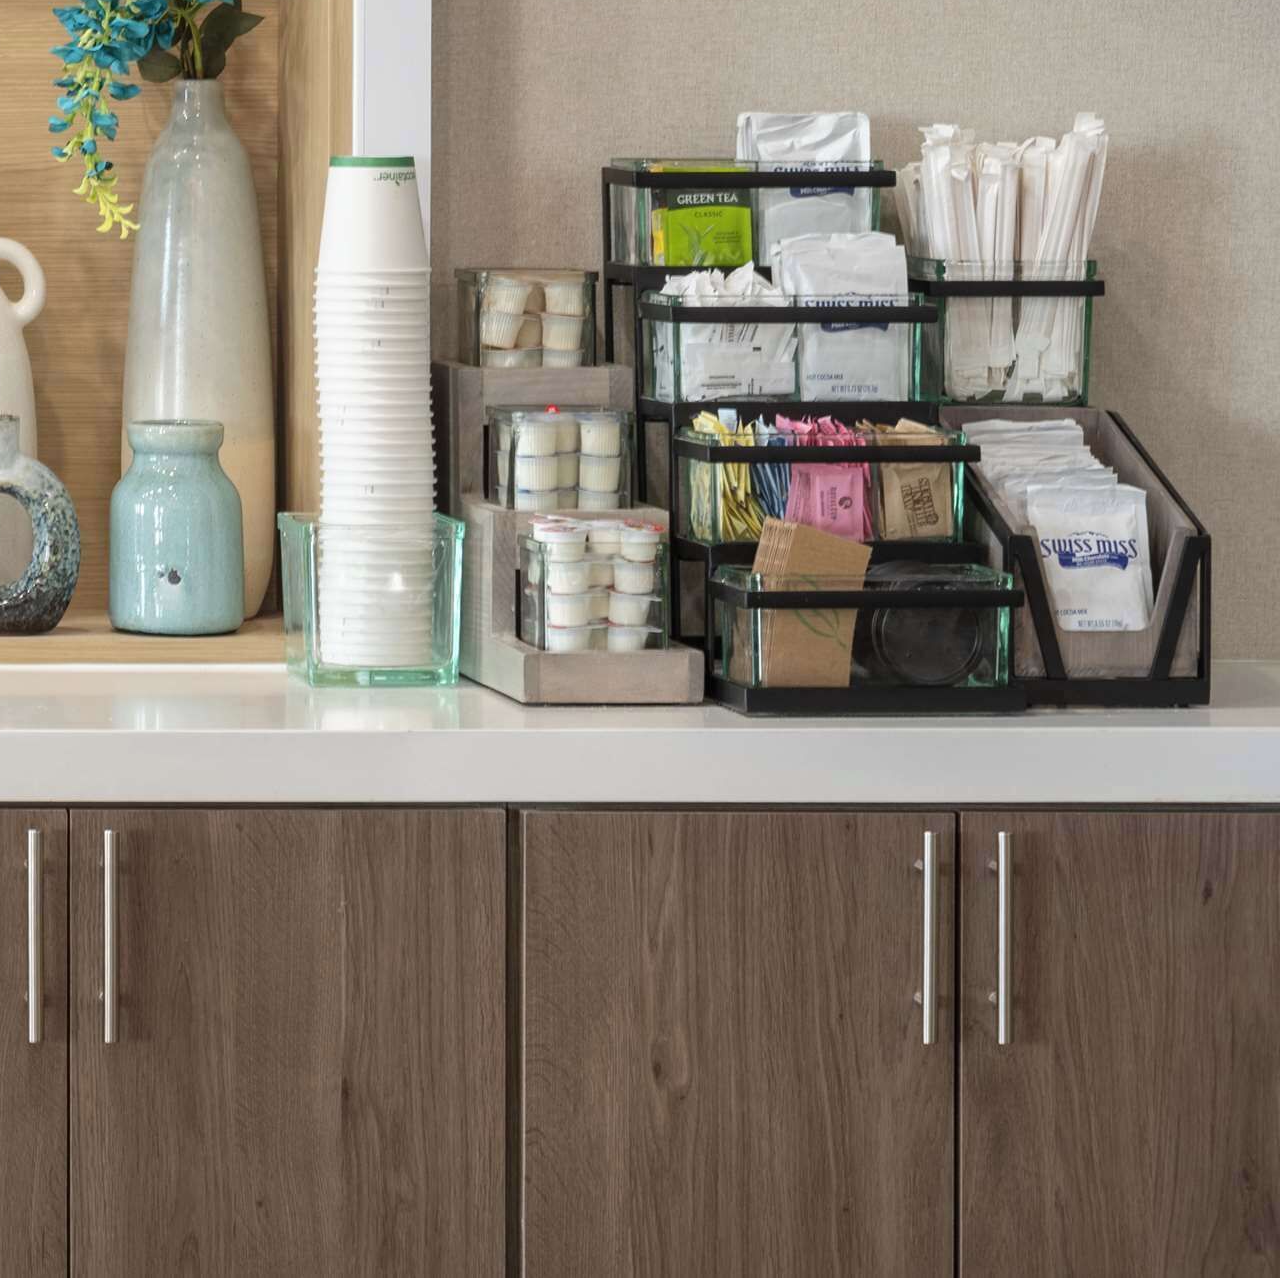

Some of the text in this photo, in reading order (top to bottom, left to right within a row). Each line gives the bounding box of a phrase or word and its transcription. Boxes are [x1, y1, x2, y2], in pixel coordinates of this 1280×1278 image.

[676, 192, 739, 206] GREEN TEA
[694, 211, 723, 219] CLASSIC
[917, 477, 935, 517] SUGAR
